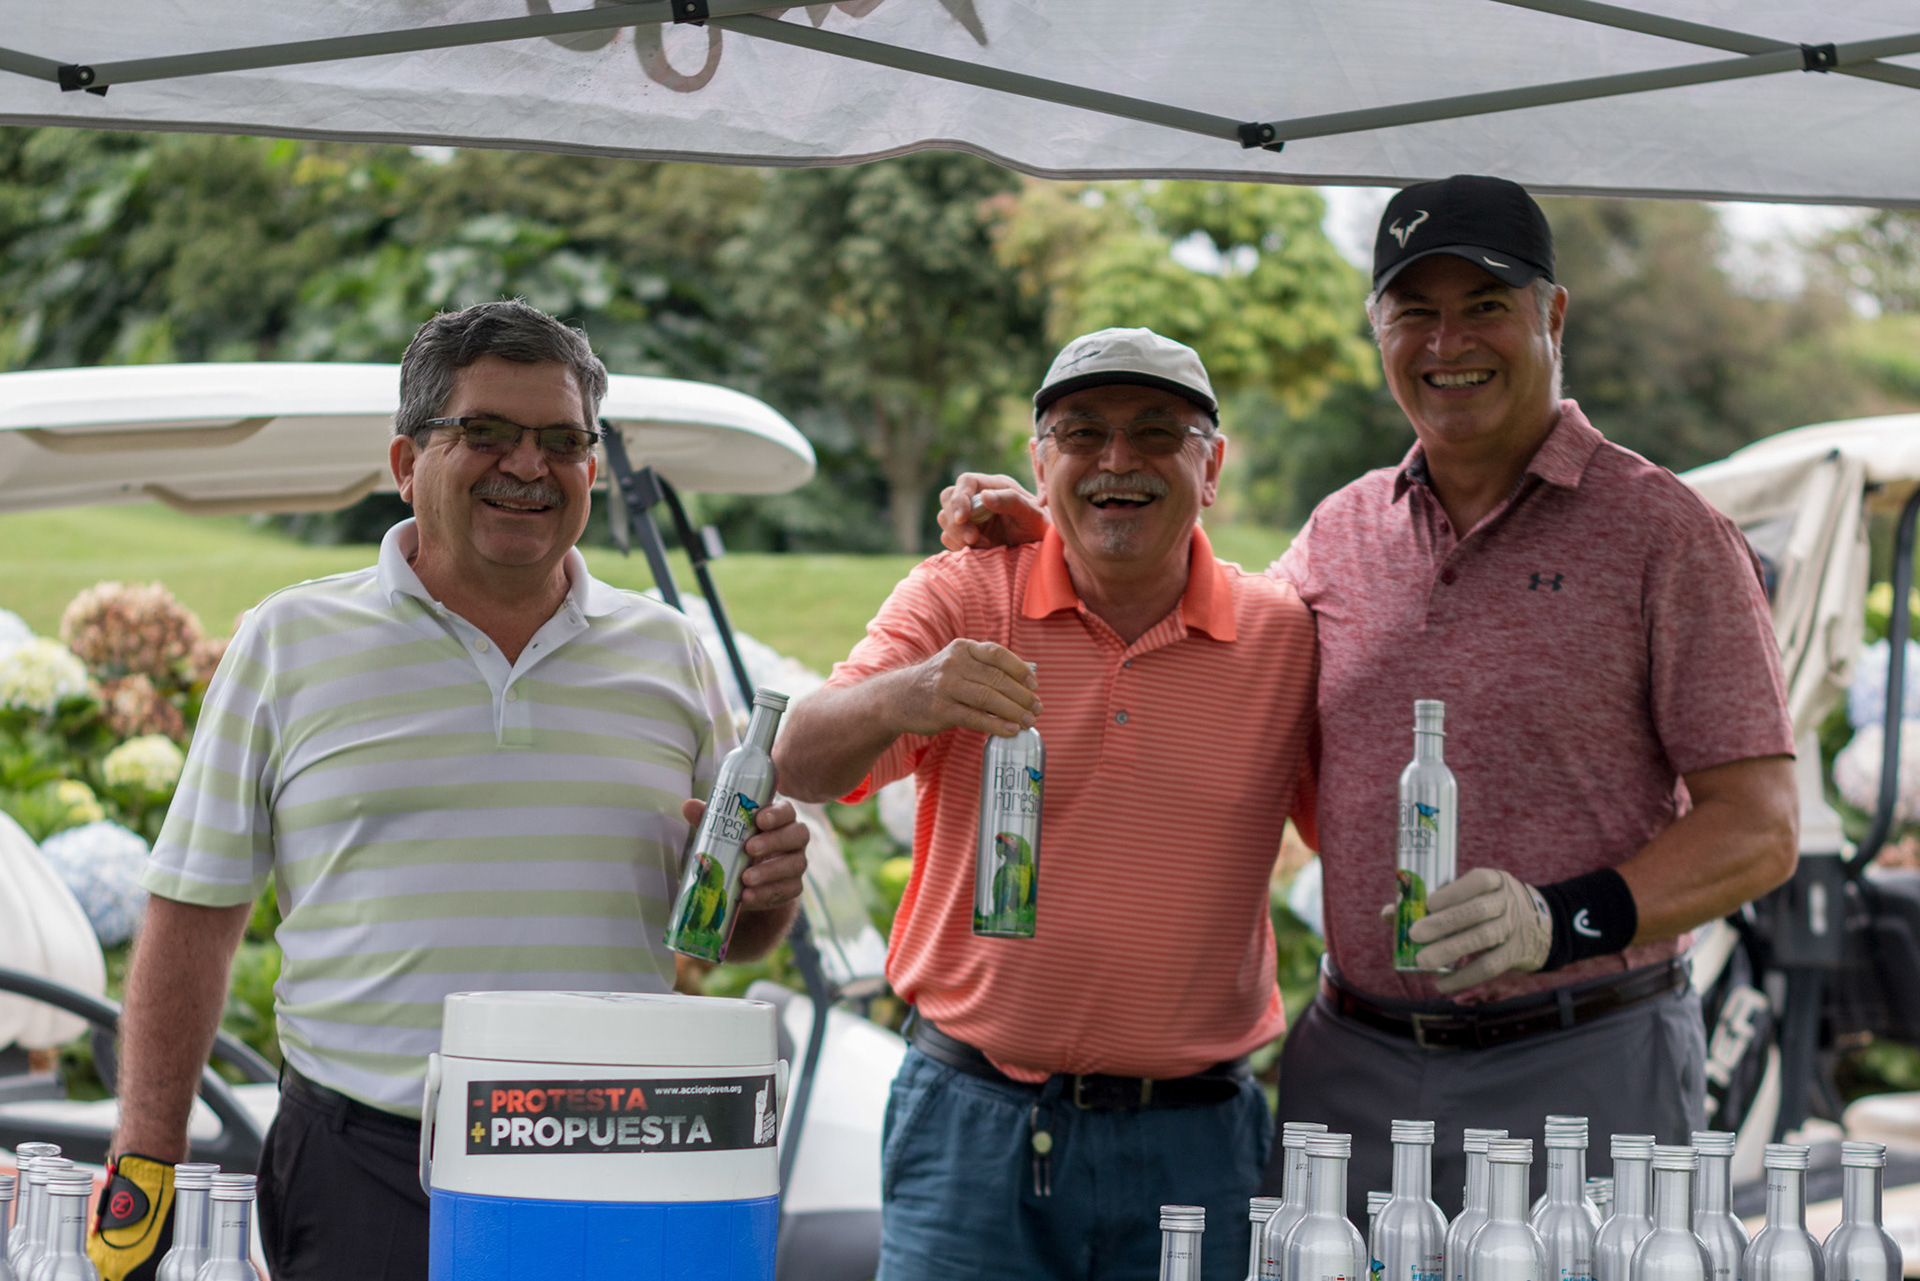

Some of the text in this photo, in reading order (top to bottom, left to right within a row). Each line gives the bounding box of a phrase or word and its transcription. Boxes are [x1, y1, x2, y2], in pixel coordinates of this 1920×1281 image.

[994, 766, 1030, 791] Rain
[1399, 804, 1421, 828] ain
[1398, 829, 1436, 849] orest
[491, 1087, 648, 1113] PROTESTA
[654, 1084, 742, 1096] www.accionjoven.org
[491, 1115, 712, 1147] PROPUESTA
